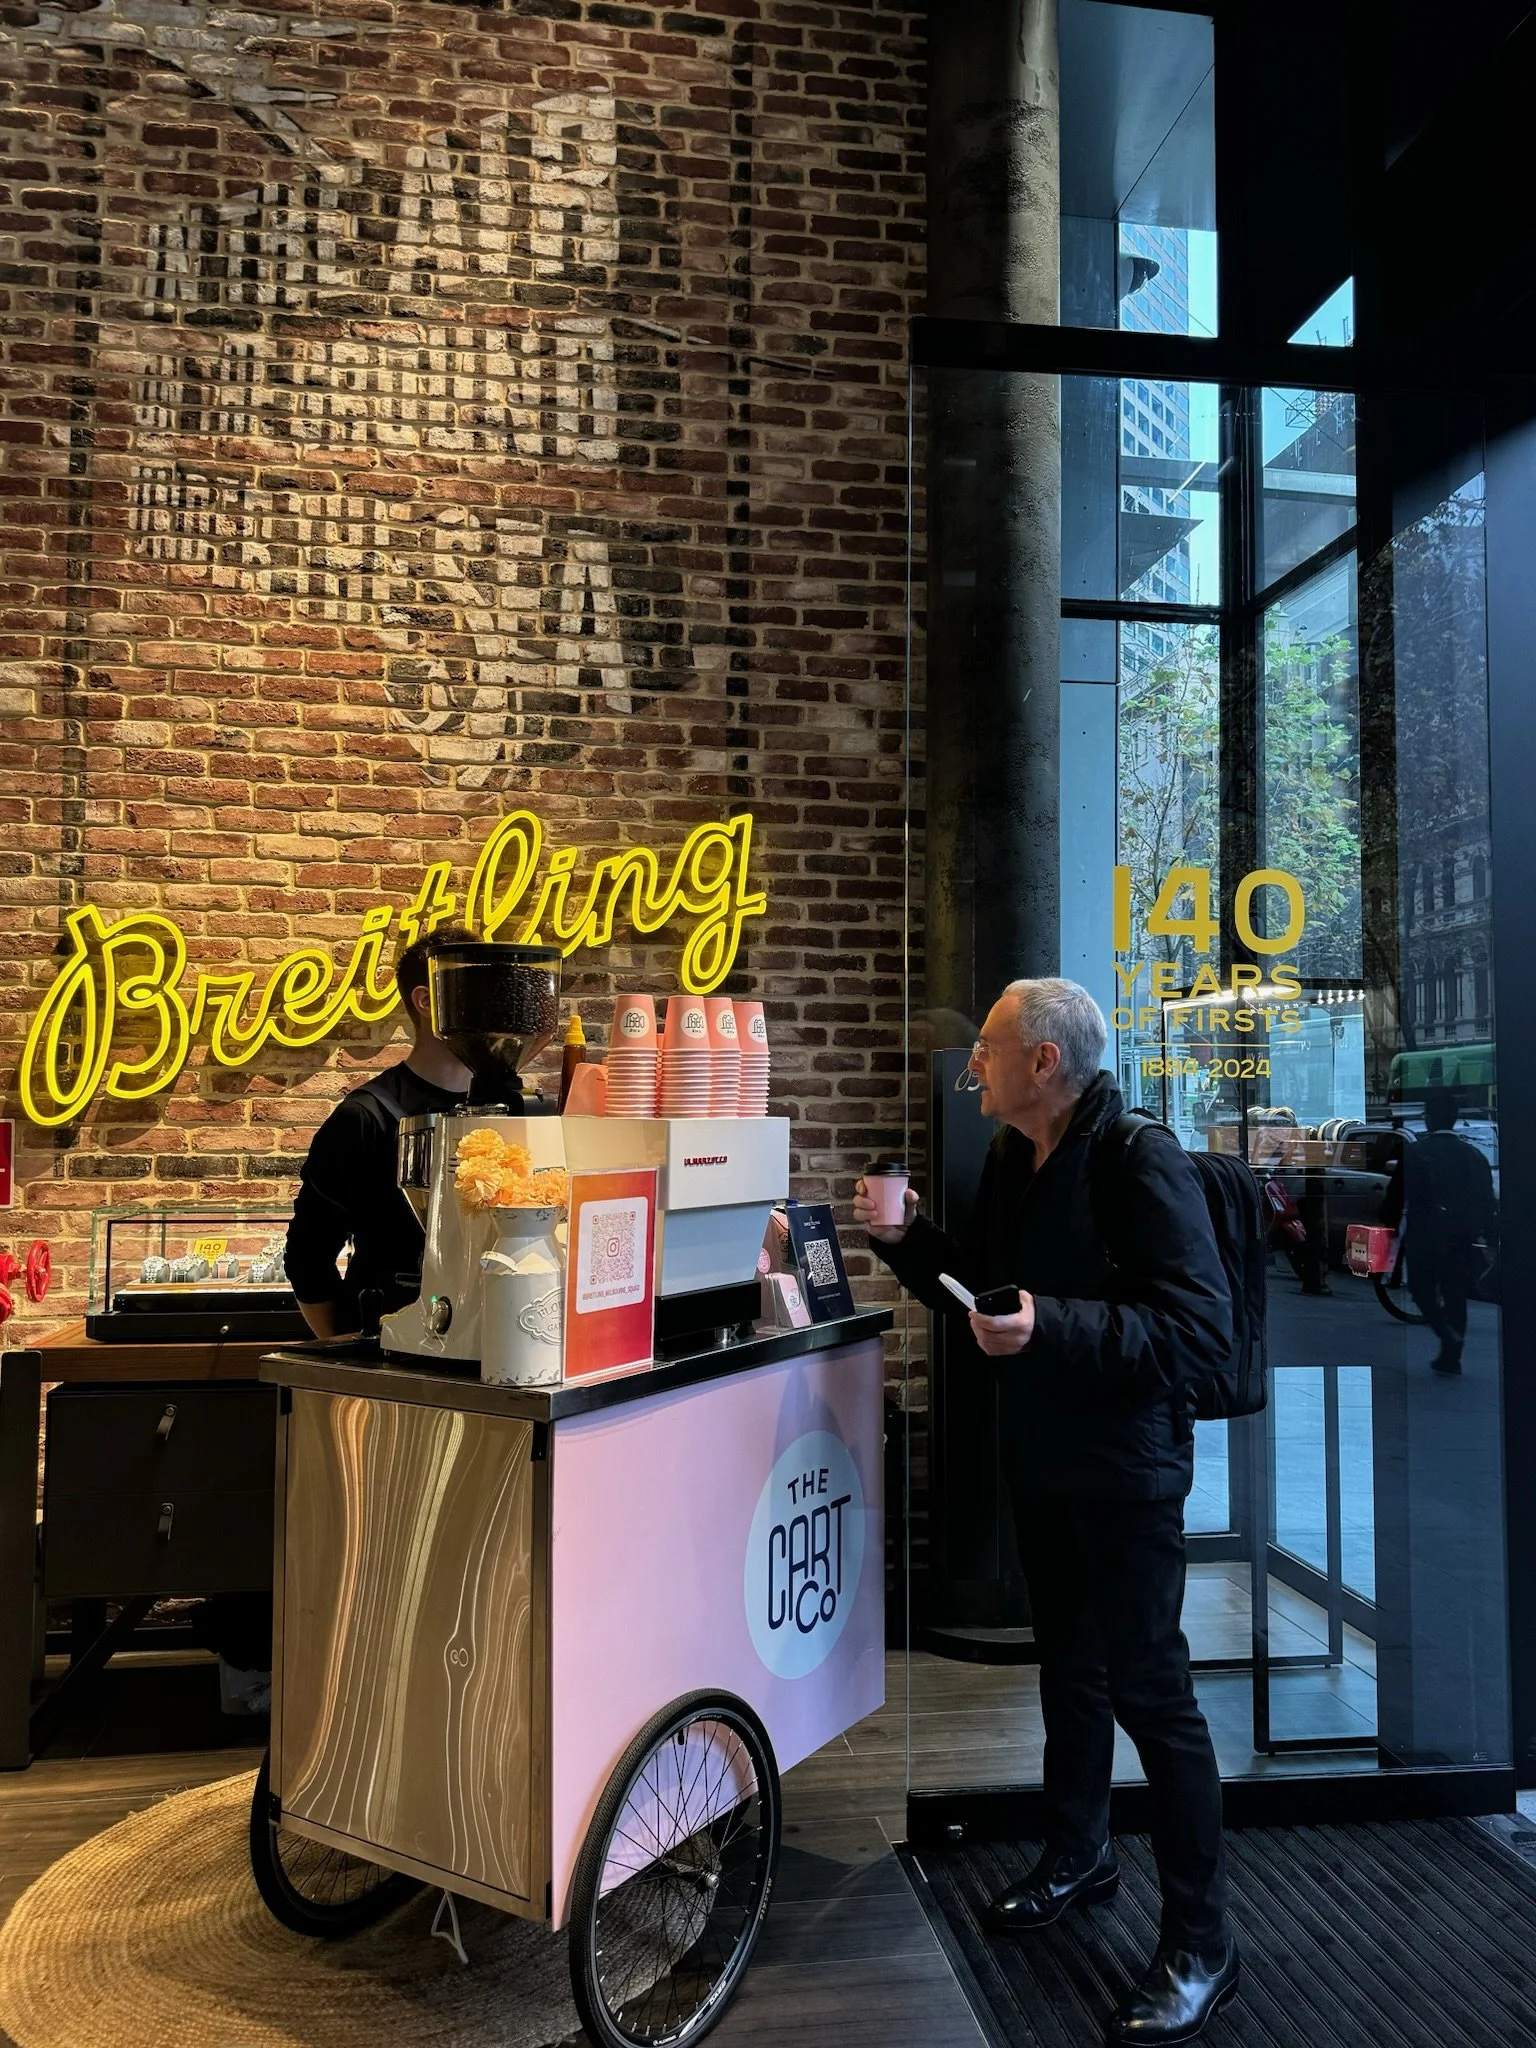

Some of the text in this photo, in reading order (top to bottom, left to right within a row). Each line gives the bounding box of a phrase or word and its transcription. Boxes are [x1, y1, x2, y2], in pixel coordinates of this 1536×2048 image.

[386, 88, 619, 300] AIR
[402, 505, 634, 765] SEA
[1112, 866, 1305, 955] 140
[20, 809, 767, 1128] Breitling
[1110, 1007, 1303, 1033] OF FIRSTS
[1112, 962, 1303, 1000] YEARS
[787, 1468, 829, 1505] THE
[768, 1494, 852, 1630] CART
